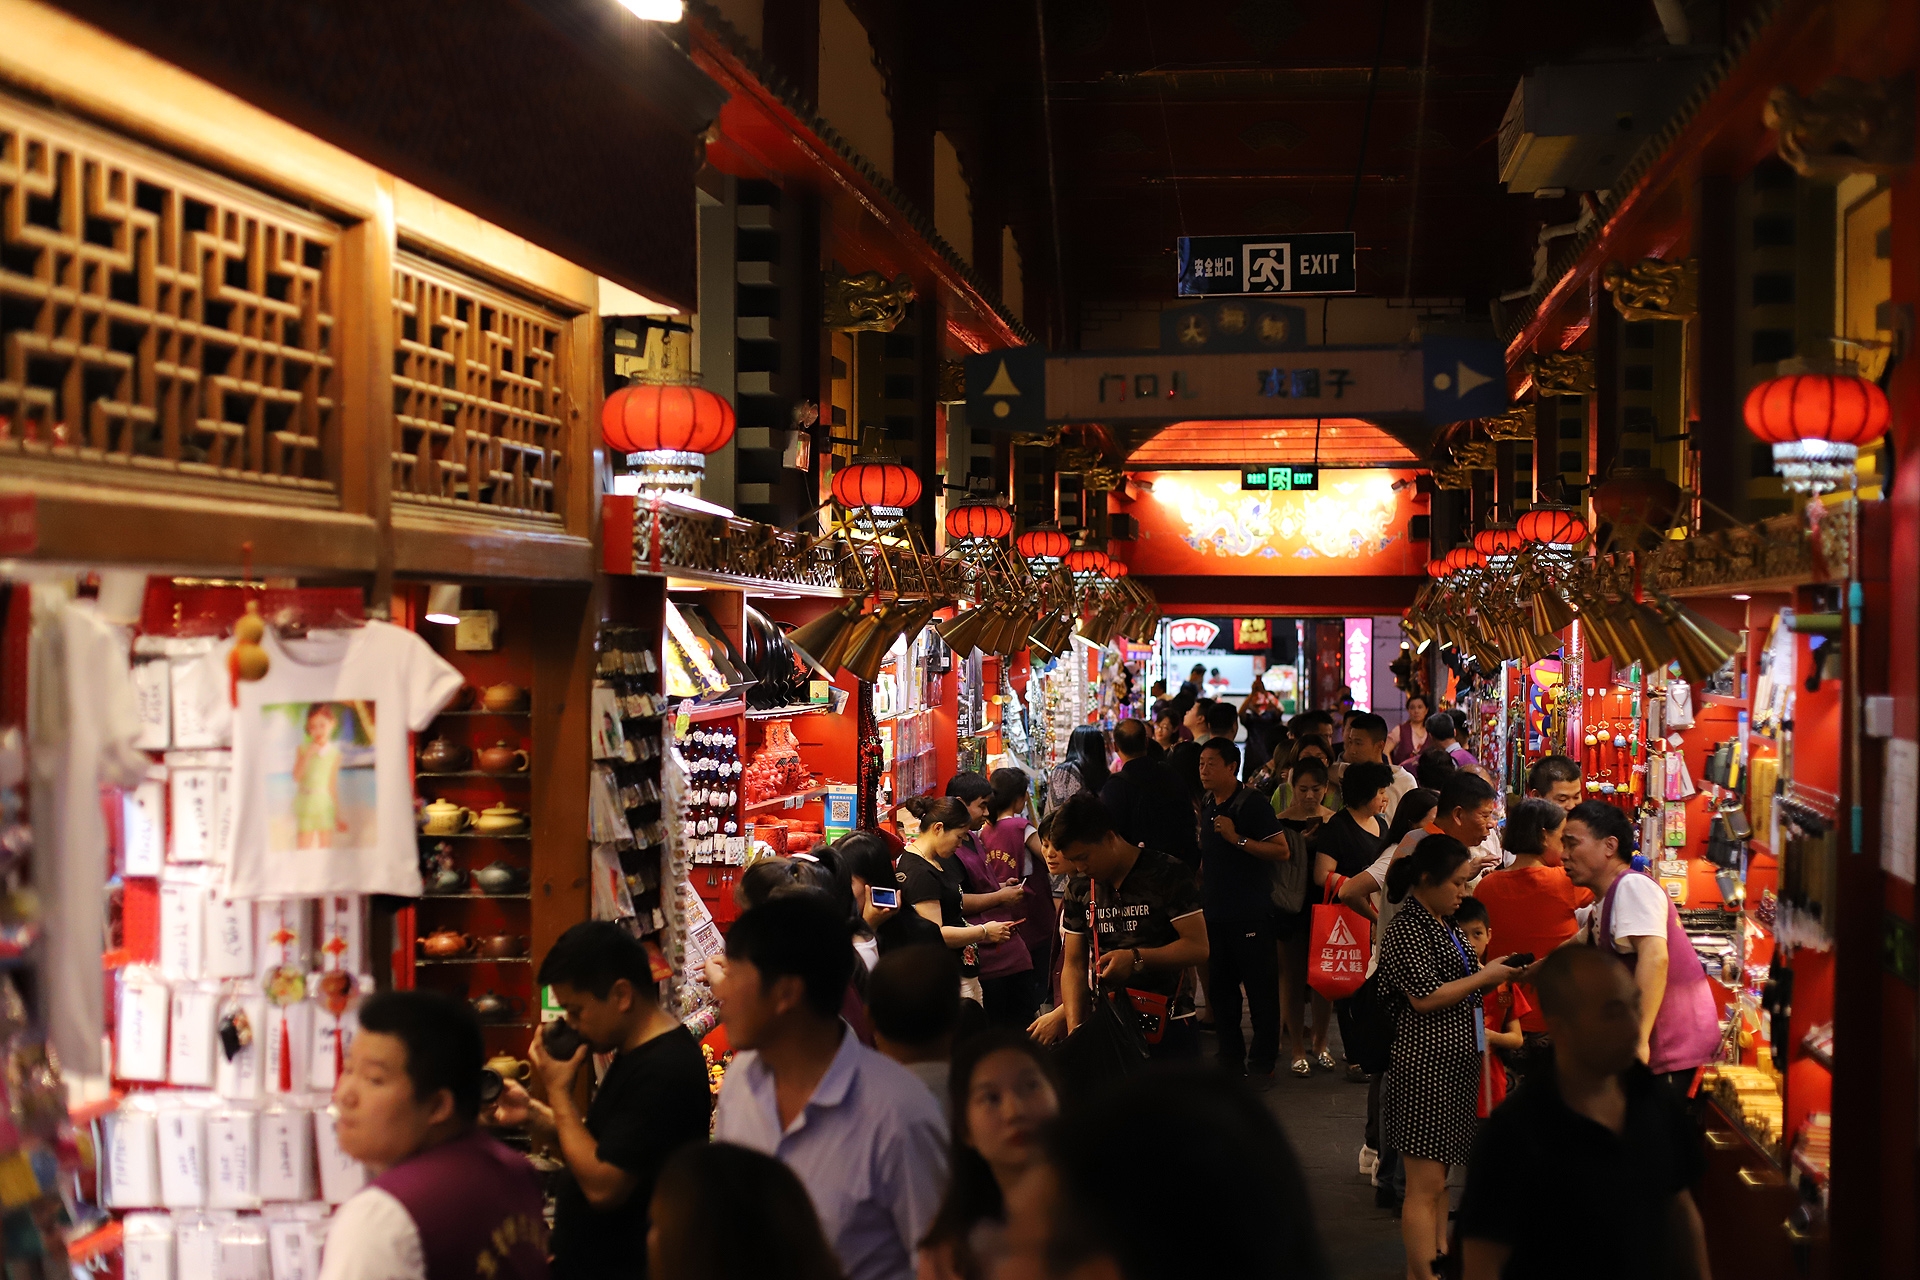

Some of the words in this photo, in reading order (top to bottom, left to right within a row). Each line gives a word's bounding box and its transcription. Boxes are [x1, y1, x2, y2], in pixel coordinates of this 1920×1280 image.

[1195, 256, 1234, 278] 安全出口
[1299, 253, 1340, 275] EXIT
[1293, 472, 1313, 485] EXIT
[1321, 947, 1362, 960] 足力健
[1320, 960, 1363, 973] 老人鞋
